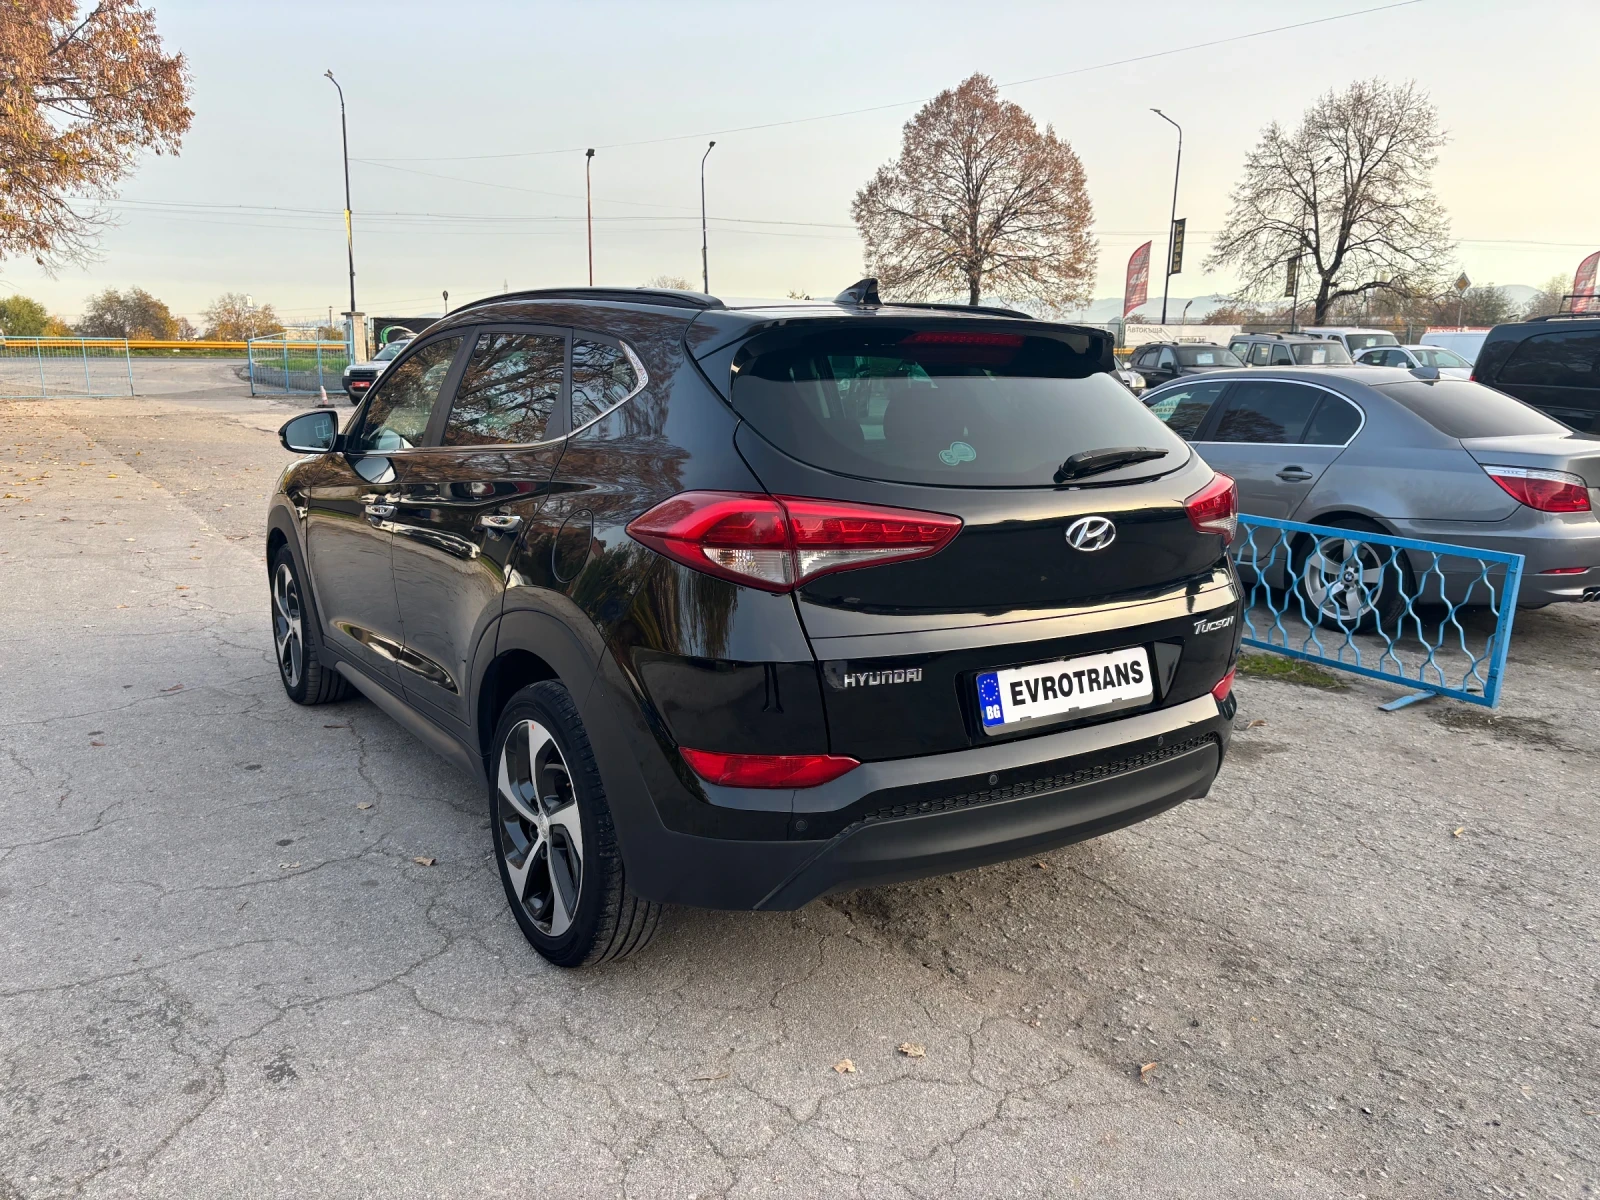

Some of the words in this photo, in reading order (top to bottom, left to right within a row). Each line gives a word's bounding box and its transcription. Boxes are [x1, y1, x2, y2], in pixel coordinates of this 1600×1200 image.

[1126, 325, 1163, 334] Автокъща
[843, 668, 923, 688] HYUNDAI
[985, 704, 1001, 720] BG
[1009, 660, 1144, 706] EVROTRANS
